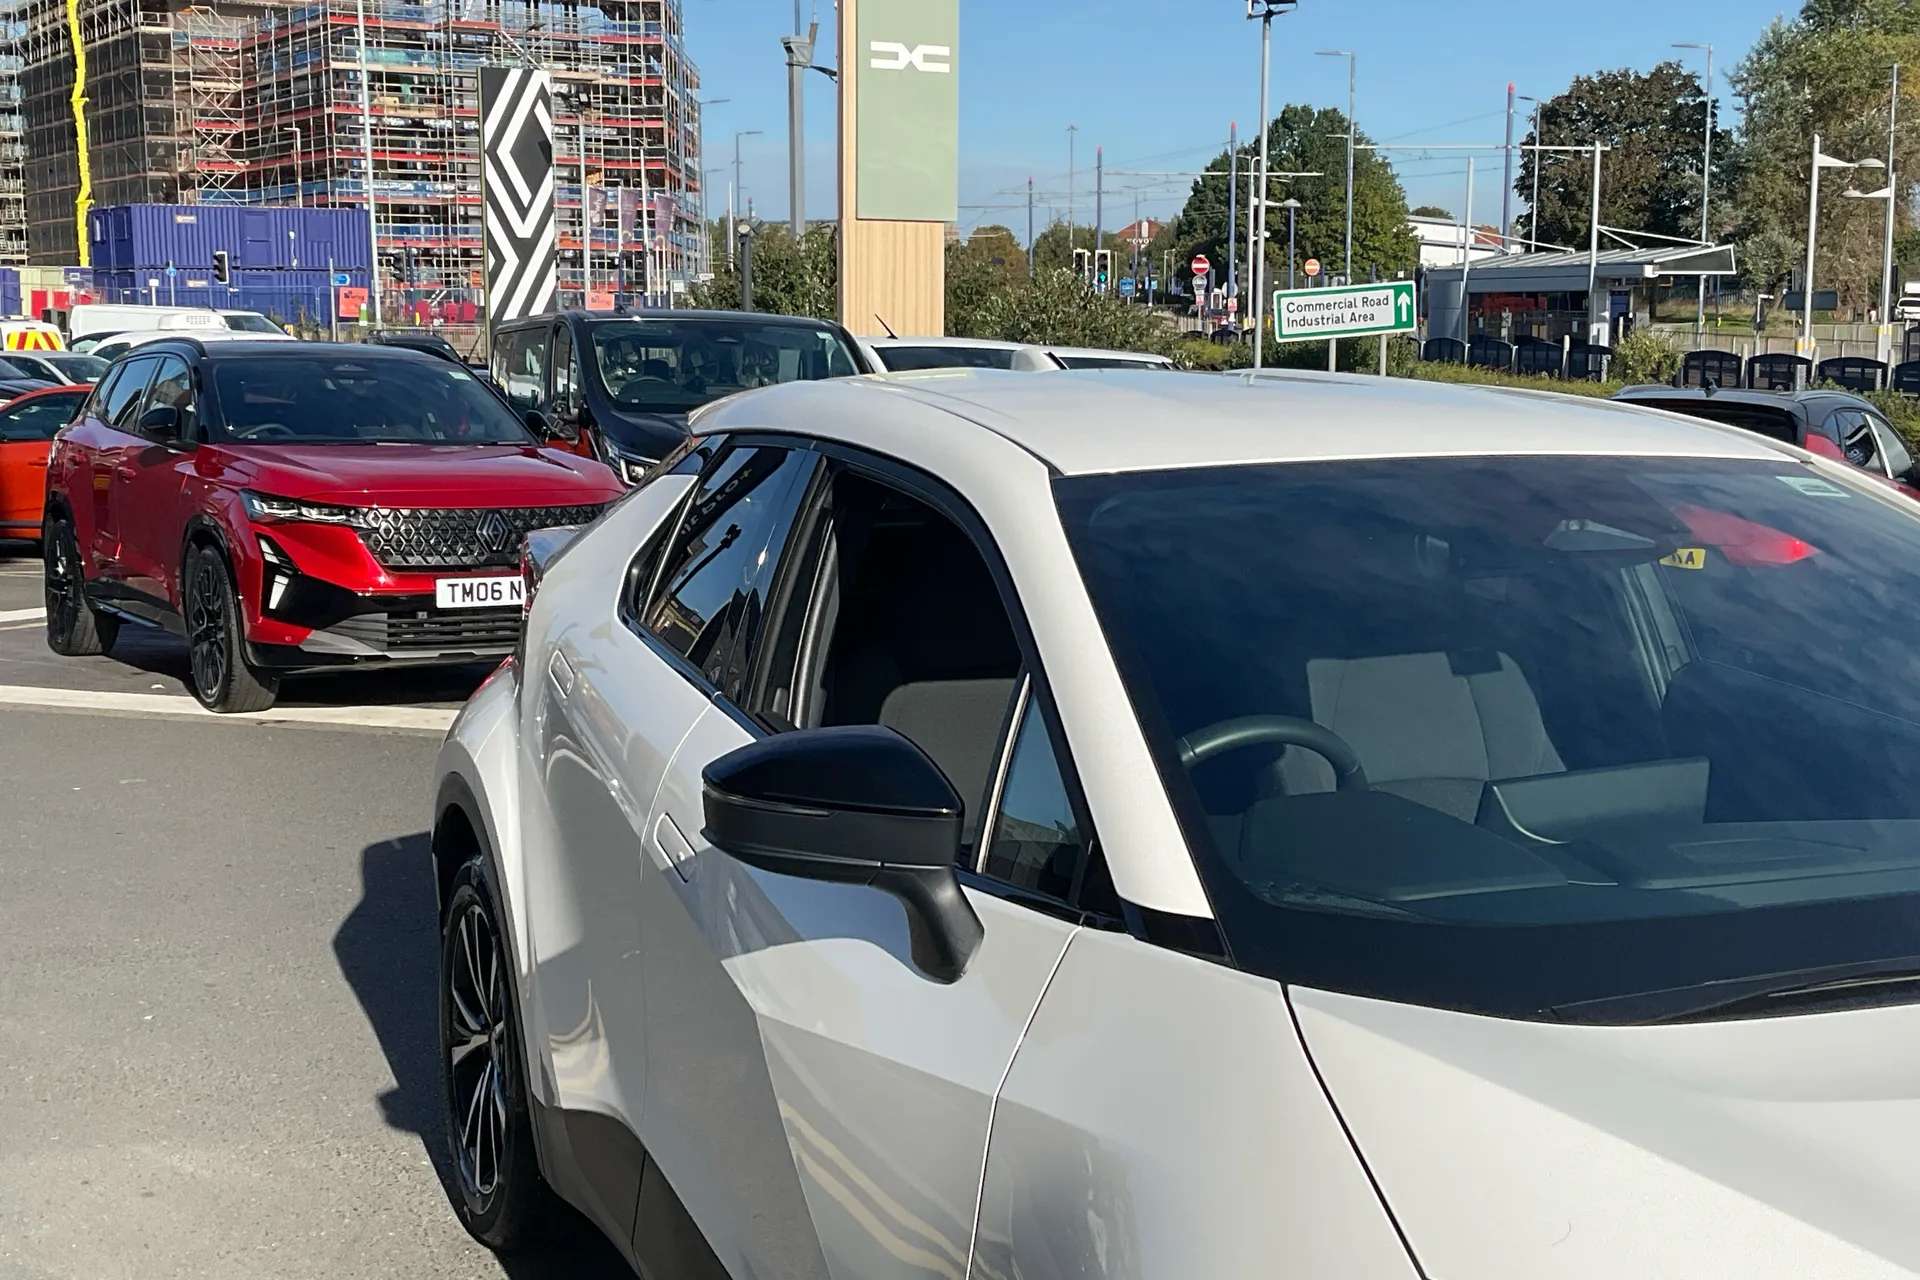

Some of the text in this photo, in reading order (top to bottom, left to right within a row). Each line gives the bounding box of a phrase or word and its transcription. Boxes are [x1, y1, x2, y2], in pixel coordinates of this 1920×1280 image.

[1286, 295, 1390, 314] Commercial Road
[1287, 311, 1375, 328] Industrial Area
[447, 582, 503, 603] TM06
